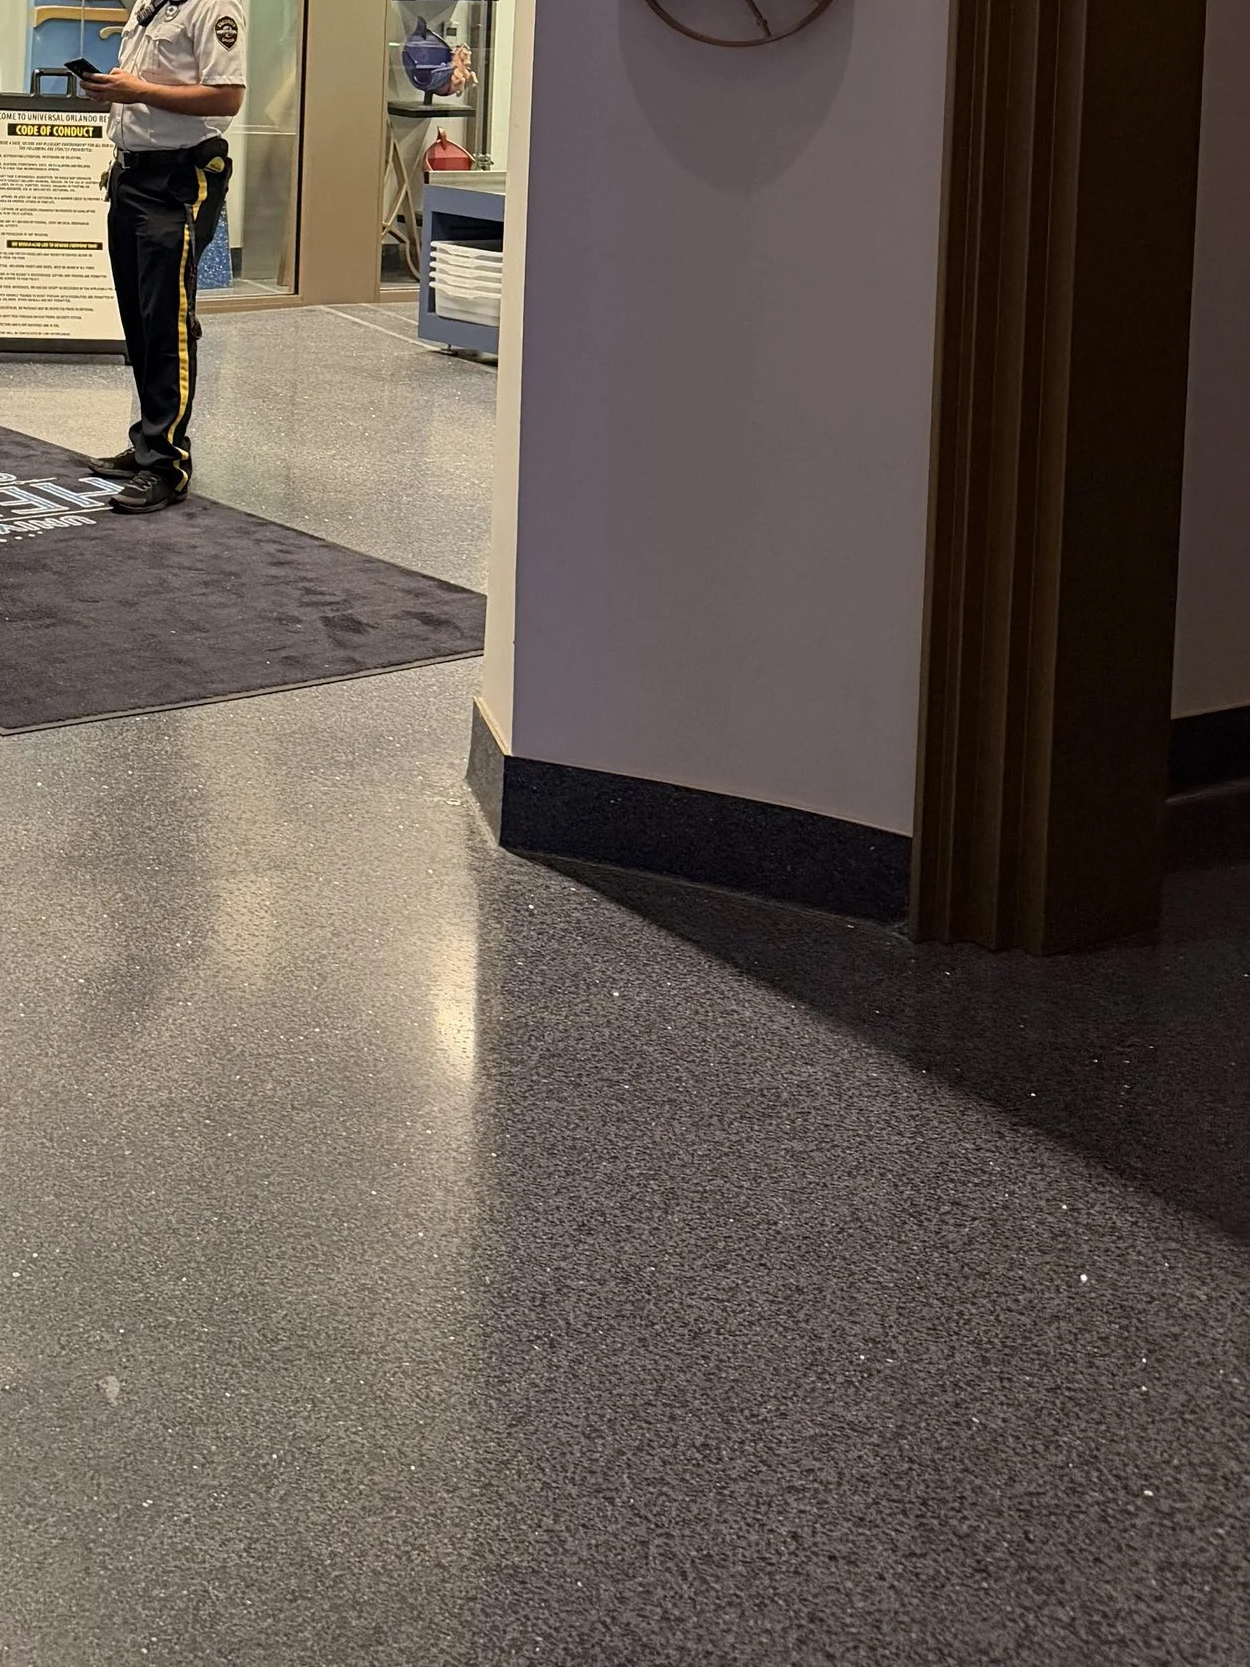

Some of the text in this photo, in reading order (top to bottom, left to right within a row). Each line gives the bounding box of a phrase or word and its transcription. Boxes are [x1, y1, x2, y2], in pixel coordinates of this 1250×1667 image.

[27, 114, 64, 122] UNIVERSAL
[16, 125, 94, 137] CODE OF CONDUCT
